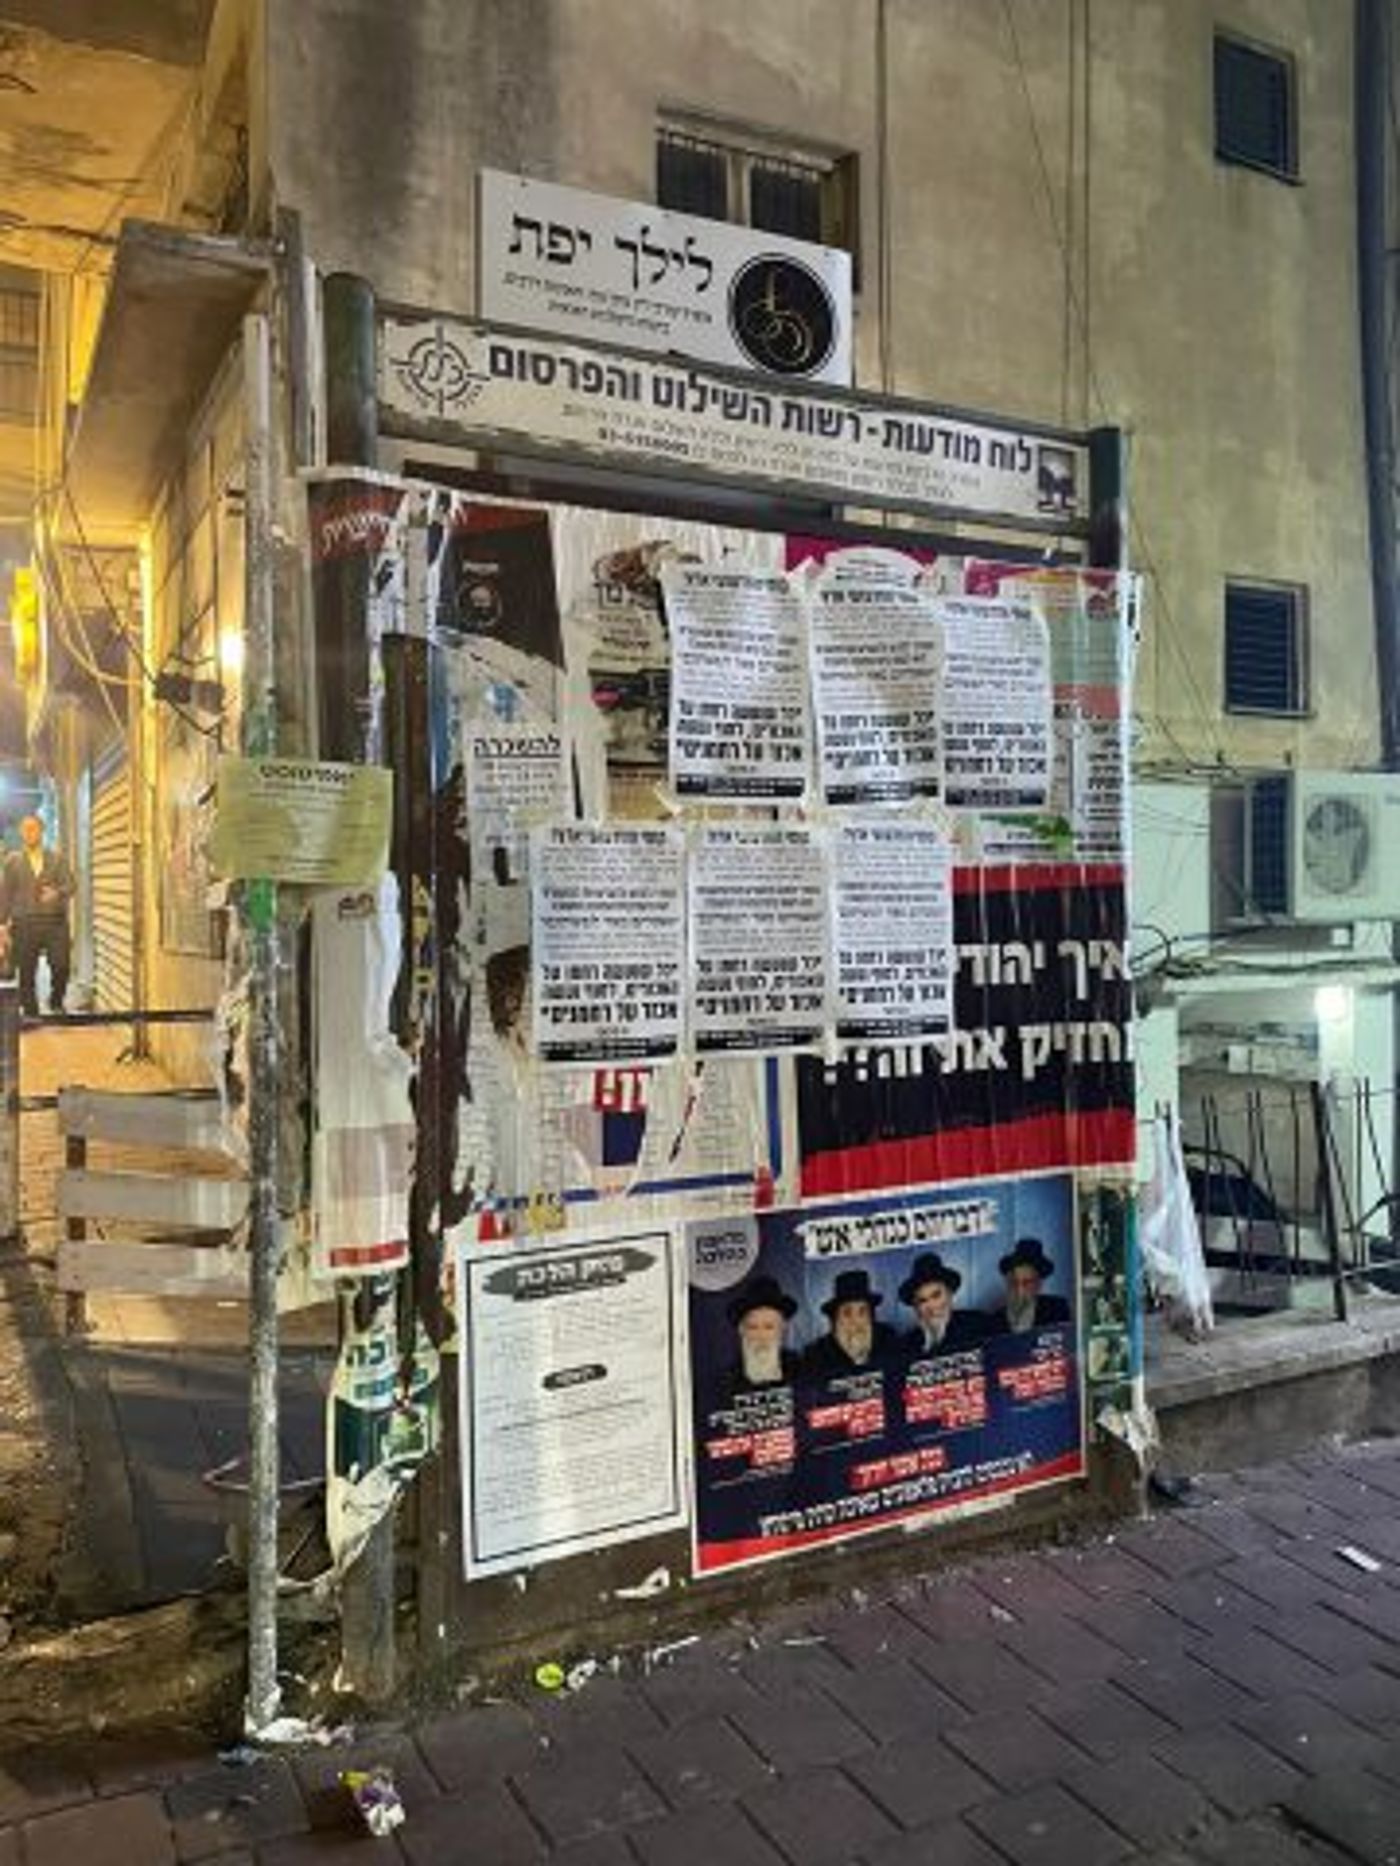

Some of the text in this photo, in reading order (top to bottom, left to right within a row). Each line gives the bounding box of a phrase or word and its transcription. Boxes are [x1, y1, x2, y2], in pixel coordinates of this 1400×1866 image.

[508, 211, 714, 293] לילך יפת
[489, 344, 641, 403] והפרסום
[651, 366, 772, 429] השילוט
[781, 399, 862, 441] רשות
[987, 437, 1034, 474] לוח
[1057, 939, 1133, 1000] איך
